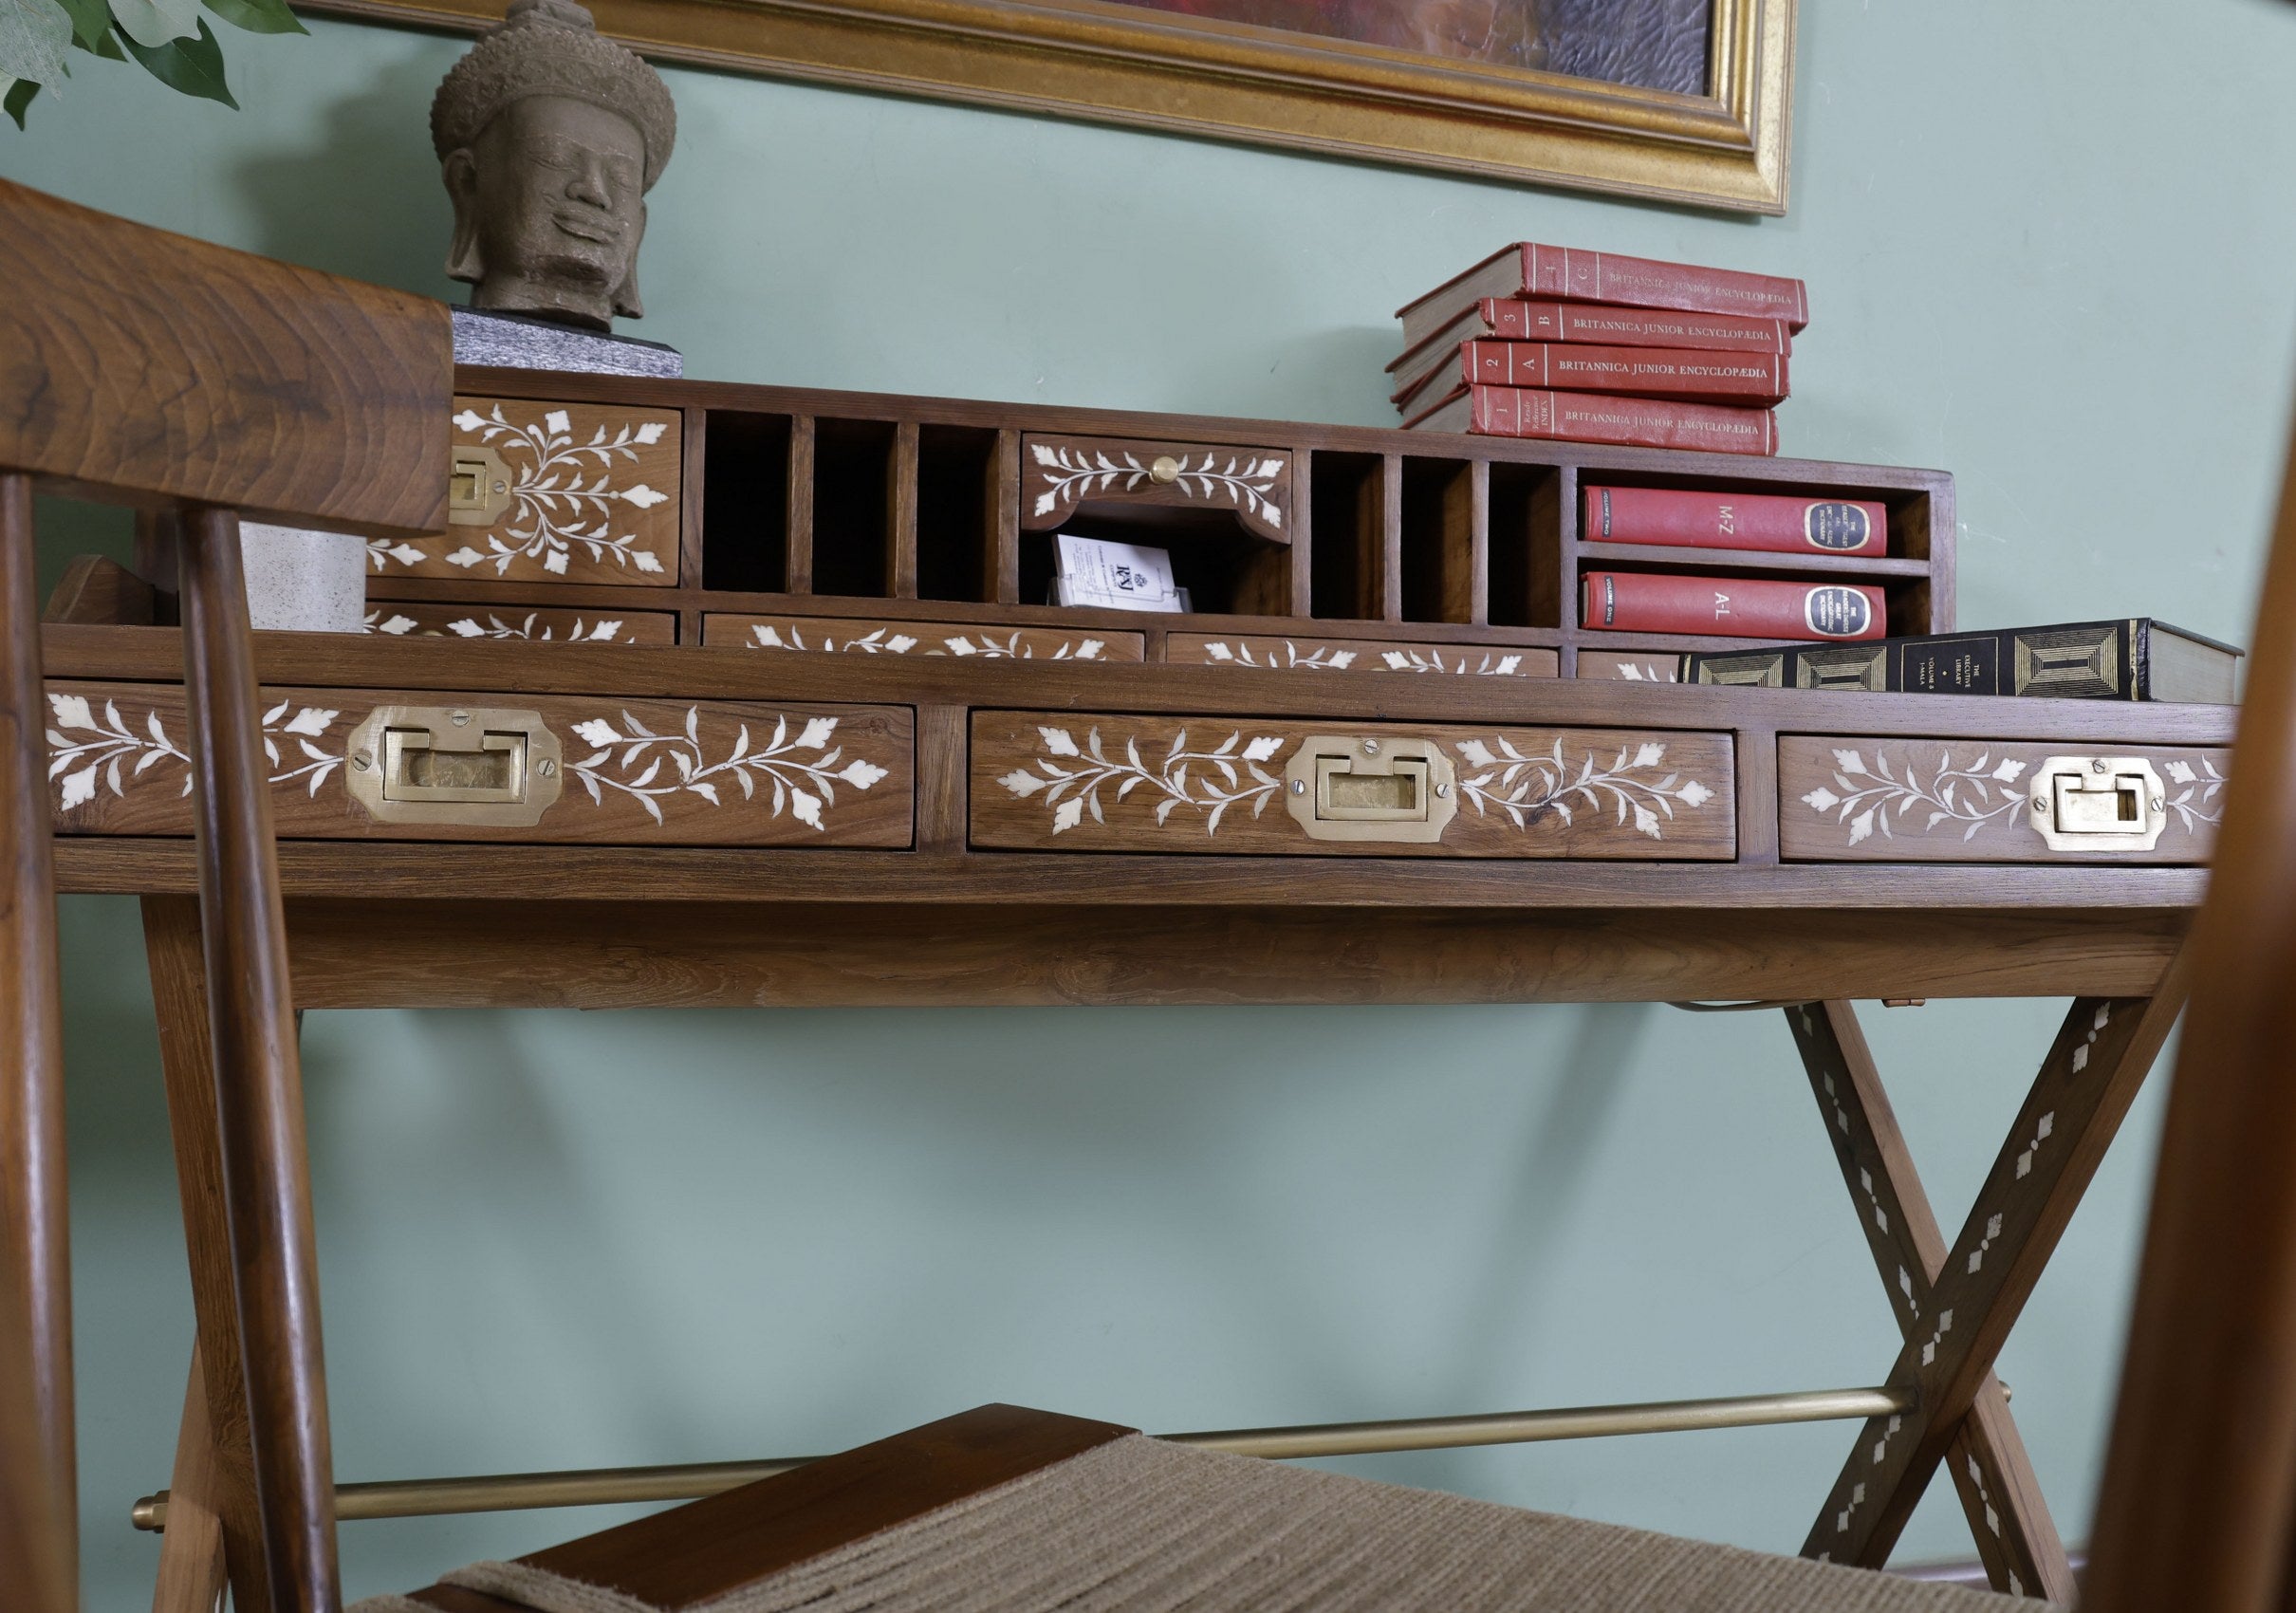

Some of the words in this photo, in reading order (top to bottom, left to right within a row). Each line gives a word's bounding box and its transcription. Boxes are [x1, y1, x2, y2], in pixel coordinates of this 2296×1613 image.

[1578, 268, 1587, 280] C
[1609, 273, 1671, 289] BRITANNICA
[1674, 281, 1712, 294] JUNIOR
[1538, 316, 1550, 325] B
[1573, 318, 1641, 332] BRITANNICA
[1643, 324, 1684, 335] JUNIOR
[1689, 328, 1771, 341] ENCYCLOPÆDIA
[1487, 359, 1498, 367] 2
[1523, 359, 1535, 370] A
[1559, 361, 1629, 373] BRITANNICA
[1632, 363, 1676, 376] JUNIOR
[1679, 365, 1768, 379] ENCYCLOPÆDIA
[1565, 411, 1631, 426] BRITANNICA
[1634, 417, 1674, 429] JUNIOR
[1718, 506, 1734, 535] M-Z
[1117, 564, 1134, 592] RAJ
[1714, 592, 1731, 621] A-L
